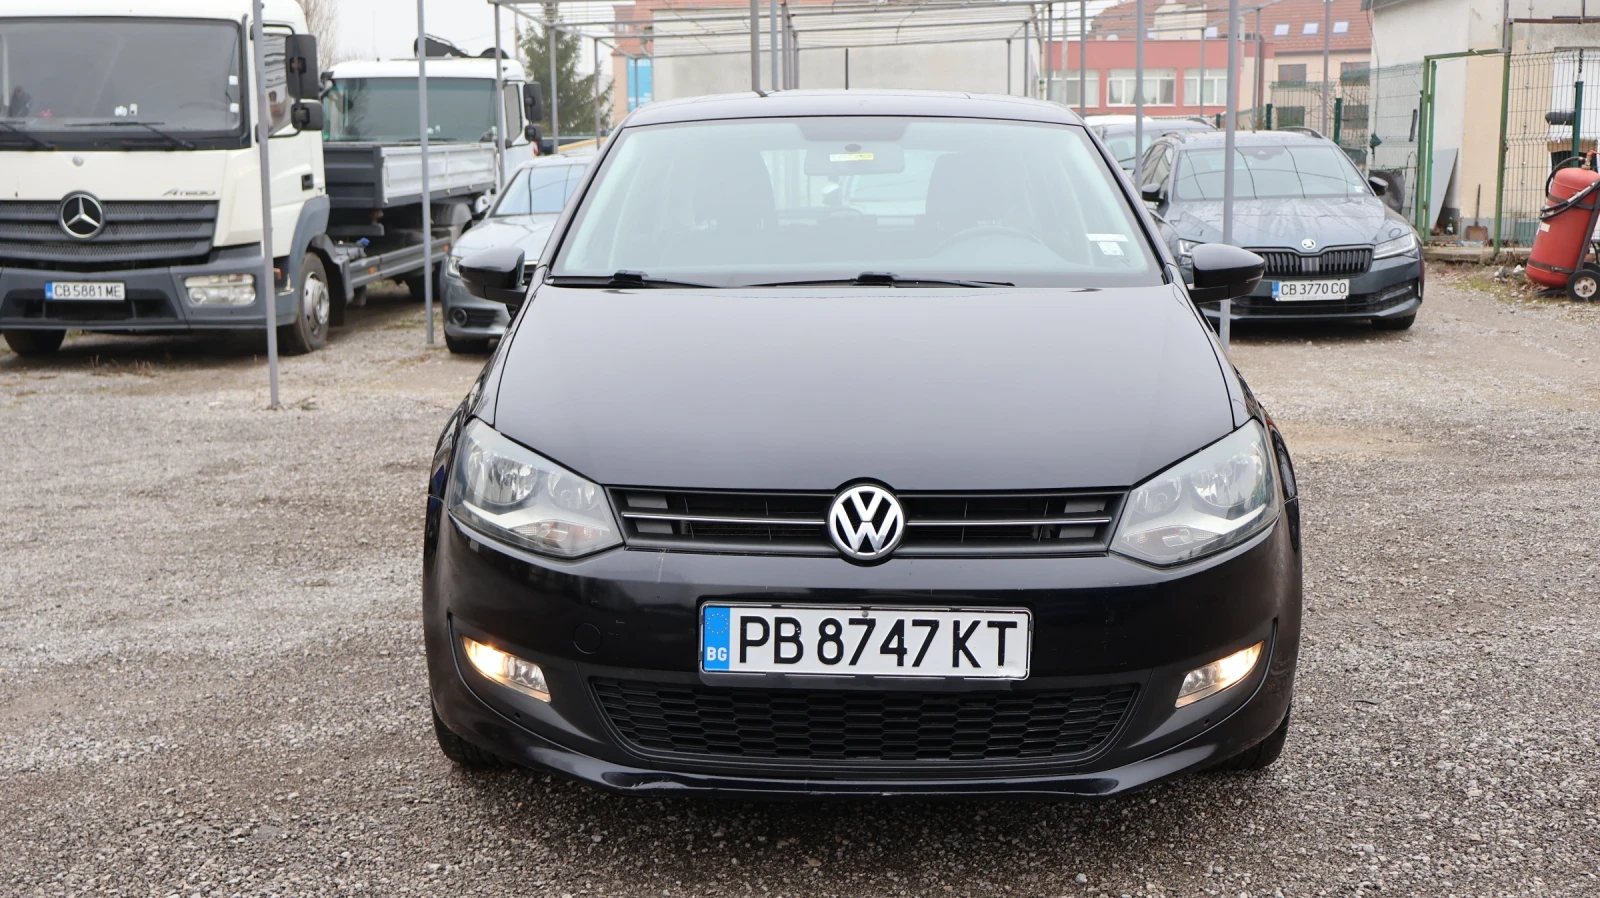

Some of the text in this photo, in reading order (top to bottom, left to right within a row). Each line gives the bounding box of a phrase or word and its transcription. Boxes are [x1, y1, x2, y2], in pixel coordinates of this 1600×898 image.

[54, 284, 71, 297] CB
[73, 284, 102, 297] 5881
[105, 284, 122, 297] ME
[1281, 282, 1347, 296] CB 3770 CO
[739, 615, 1018, 669] PB 8747 KT
[706, 646, 727, 662] BG
